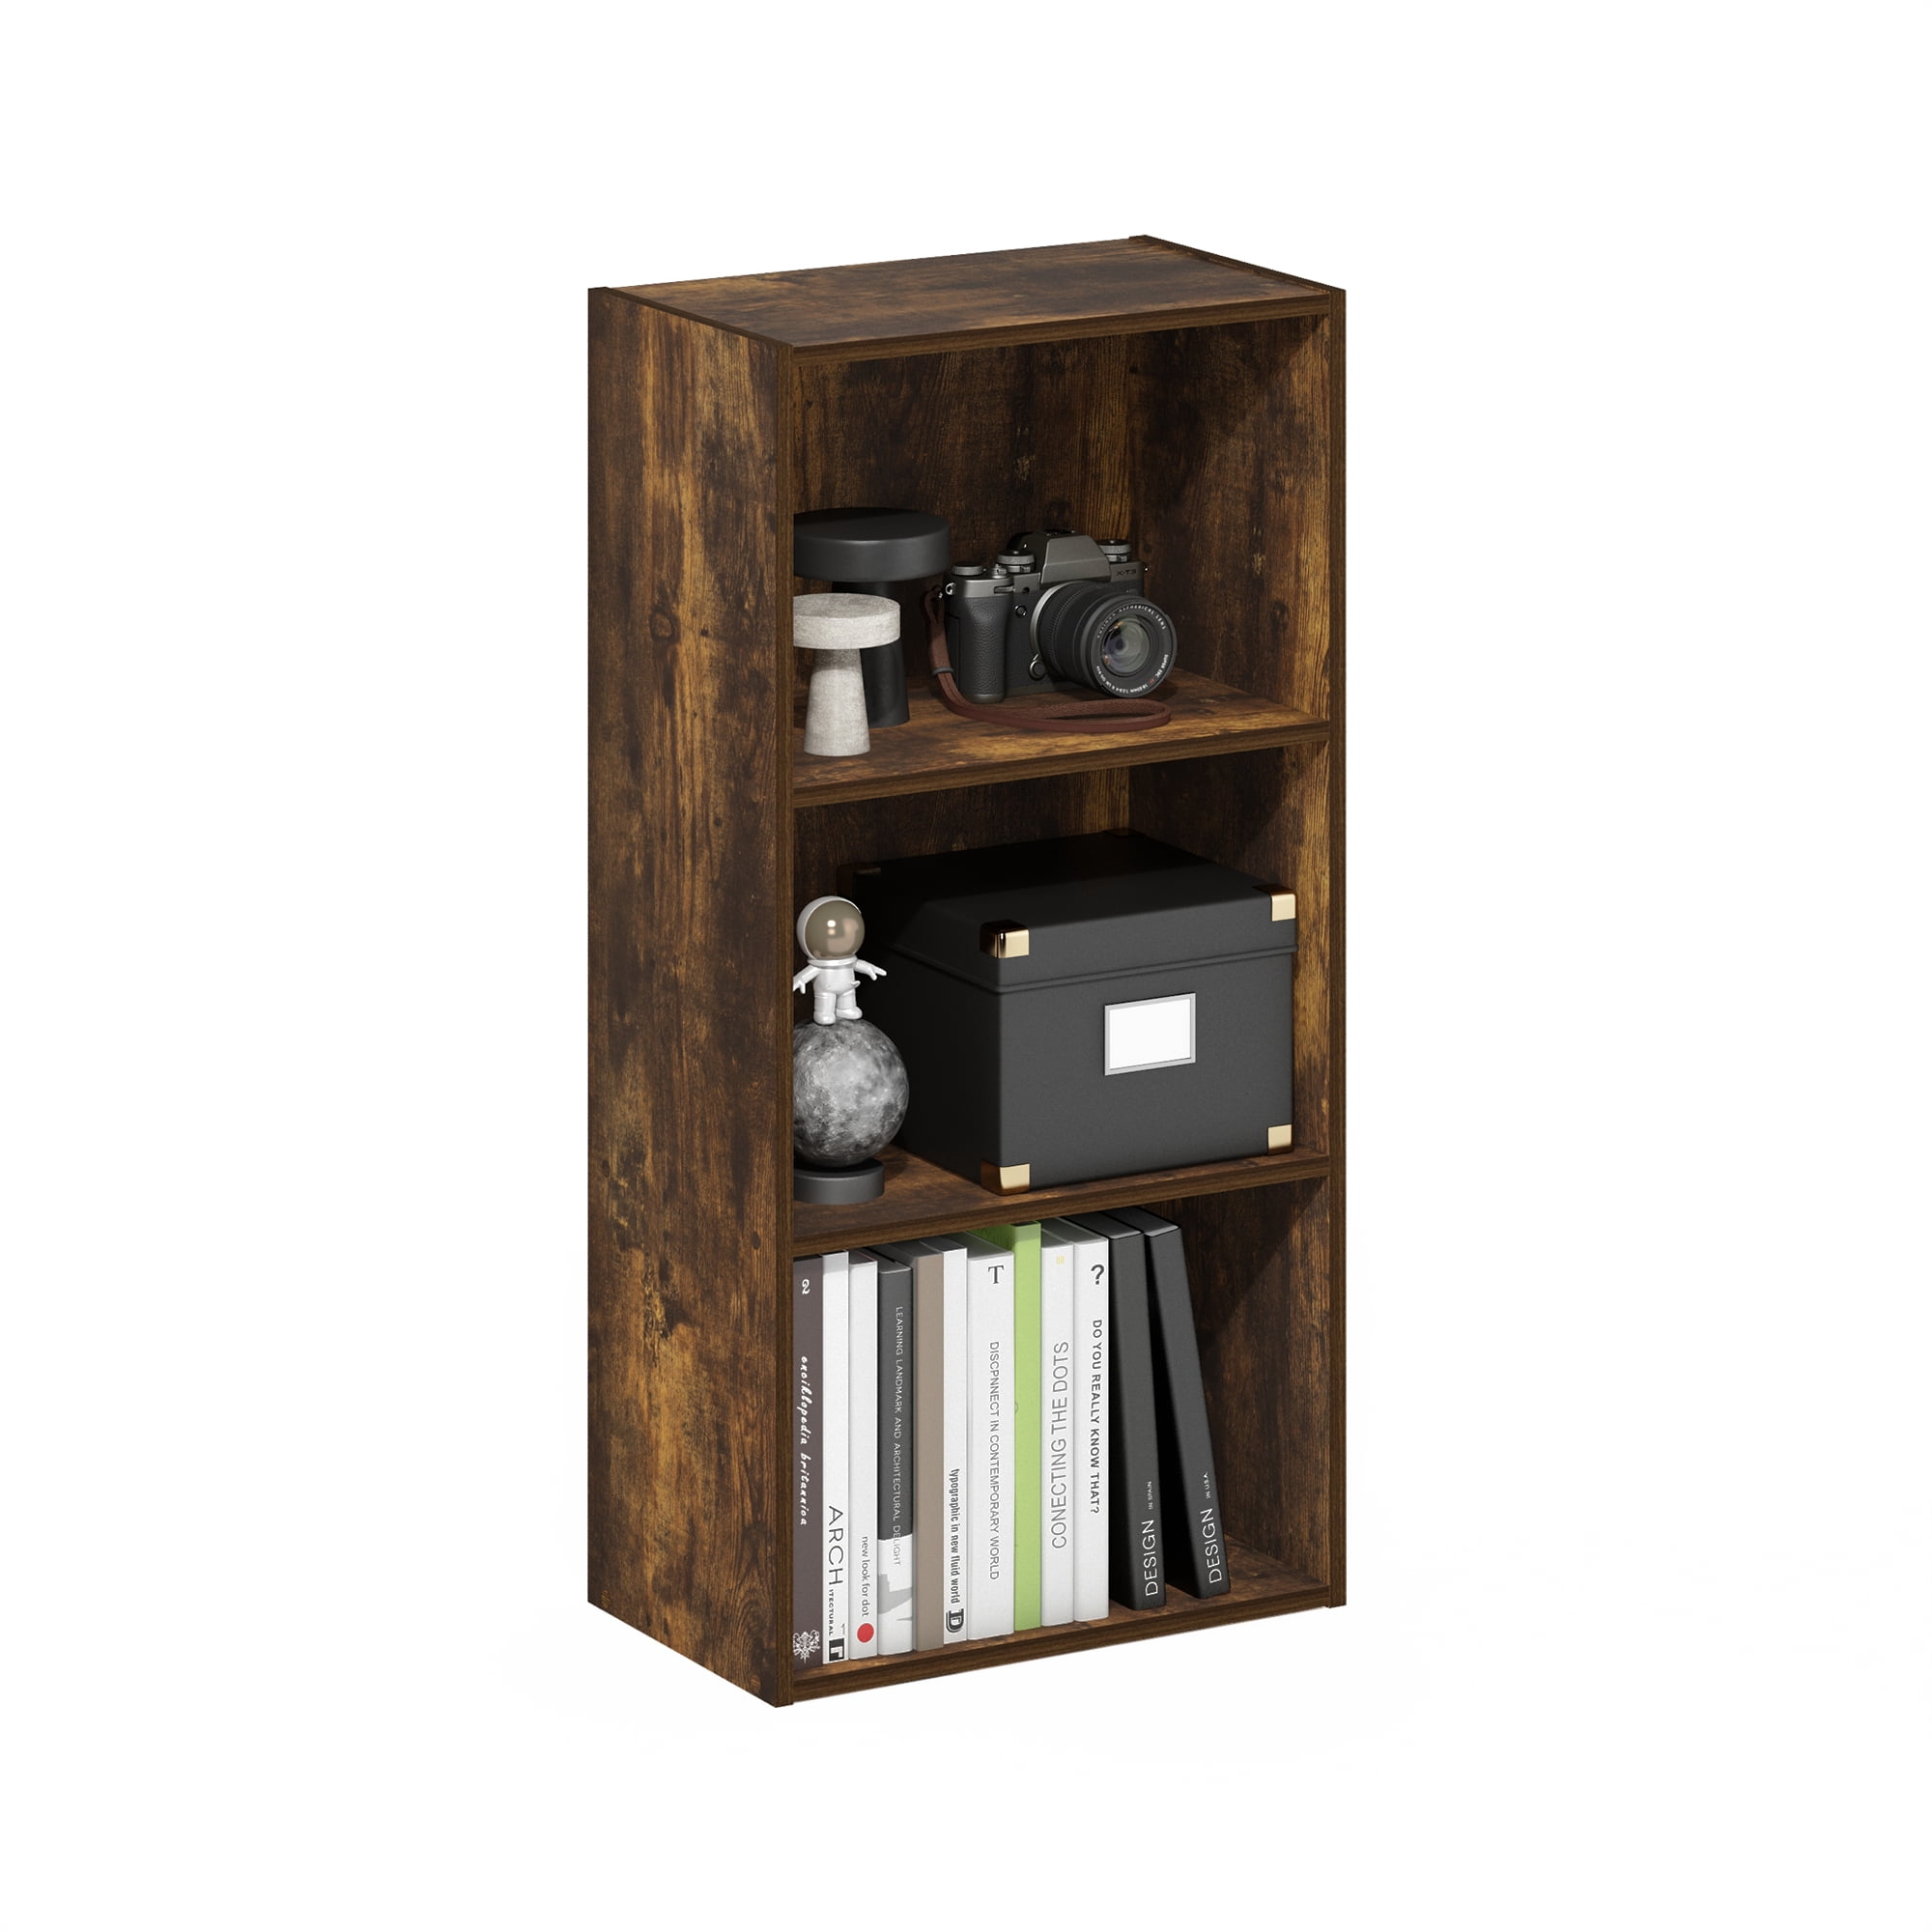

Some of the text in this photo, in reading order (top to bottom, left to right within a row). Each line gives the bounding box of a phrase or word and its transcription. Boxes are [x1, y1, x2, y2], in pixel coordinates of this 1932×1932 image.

[987, 1264, 1005, 1285] T
[1091, 1264, 1105, 1286] ?
[895, 1359, 903, 1413] LANDMARK
[1090, 1320, 1103, 1514] DO YOU REALLY KNOW THAT?
[989, 1341, 1000, 1580] DISCPNNECT IN CONTEMPORARY WORLD
[1050, 1341, 1069, 1549] CONECTING THE DOTS
[949, 1468, 960, 1522] typographic
[828, 1505, 844, 1585] ARCH
[893, 1525, 901, 1565] DELIGHT
[951, 1523, 959, 1533] in
[1200, 1508, 1223, 1584] DESIGN
[862, 1559, 870, 1581] look
[951, 1555, 960, 1577] fluid
[1141, 1520, 1158, 1597] DESIGN
[862, 1582, 870, 1599] for
[862, 1602, 870, 1617] dot
[951, 1578, 960, 1604] world
